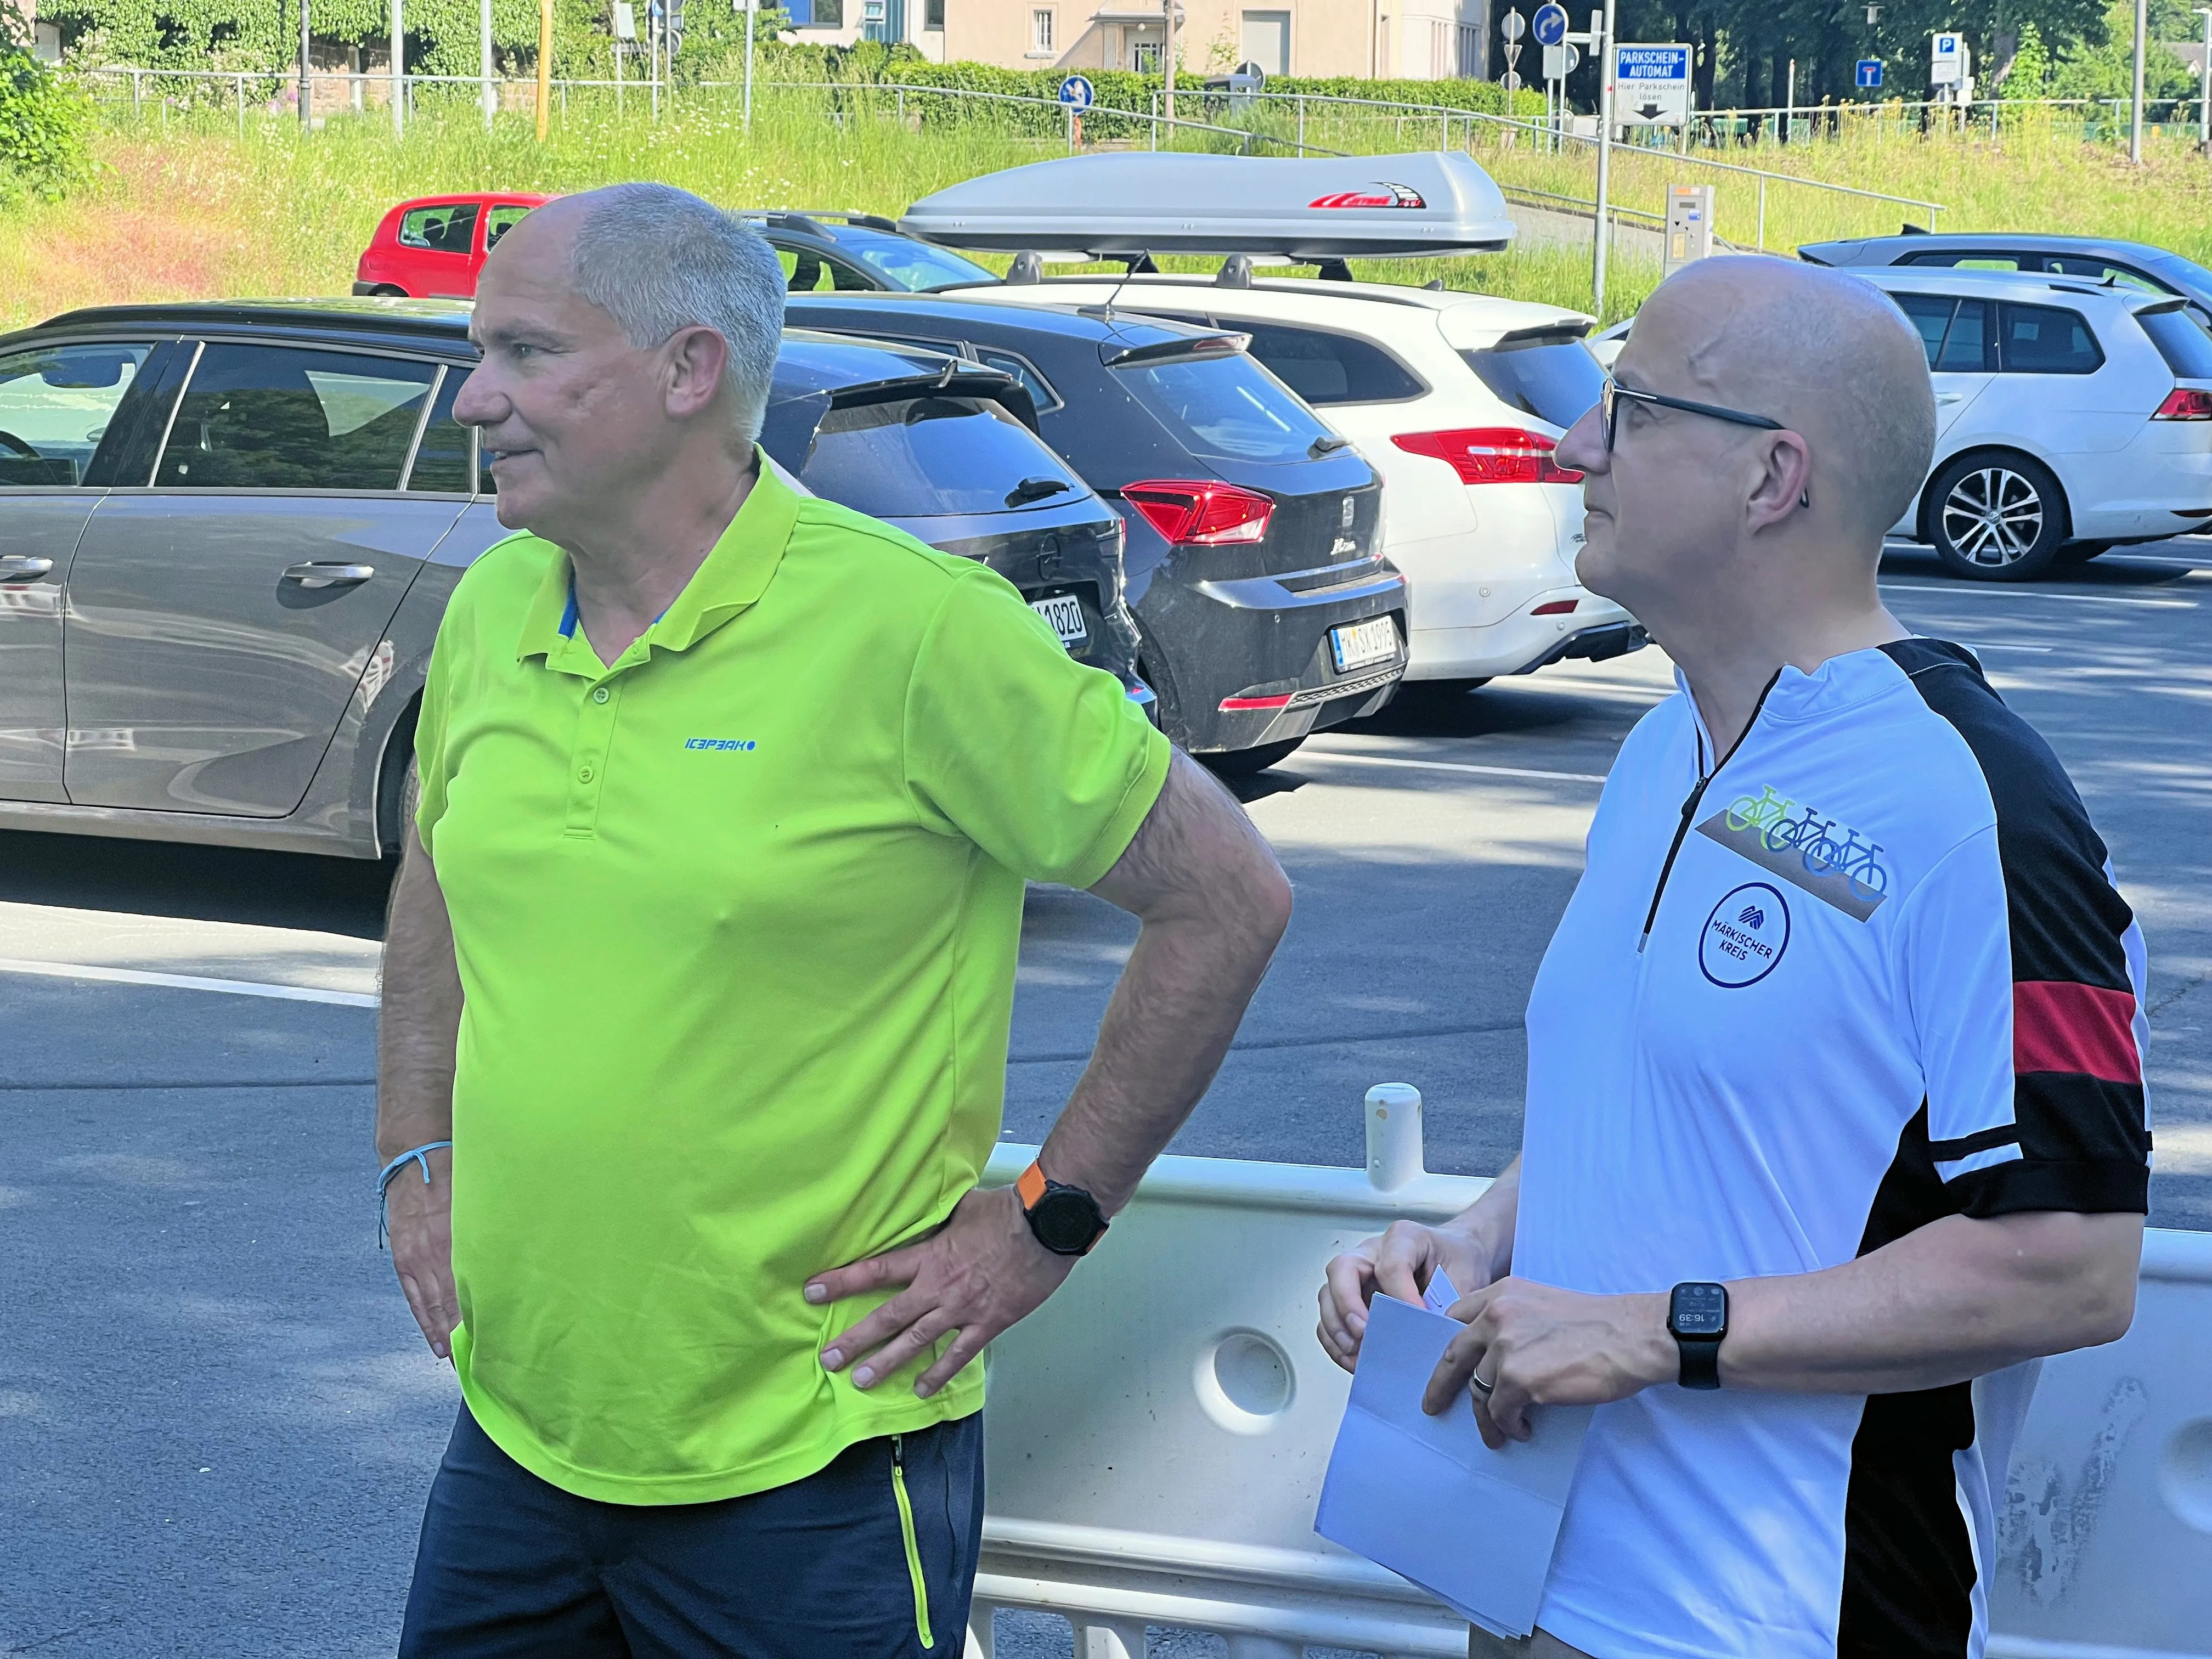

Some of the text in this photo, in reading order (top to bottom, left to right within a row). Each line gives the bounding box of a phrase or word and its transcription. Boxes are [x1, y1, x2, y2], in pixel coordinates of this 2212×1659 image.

[1620, 52, 1685, 64] PARKSCHEIN-
[1629, 65, 1673, 77] AUTOMAT
[1639, 82, 1685, 91] Parkschein
[1358, 627, 1373, 654] SX
[1711, 919, 1773, 959] MÄRKISCHER
[1719, 939, 1748, 961] KREIS
[1679, 1313, 1705, 1322] 16:39
